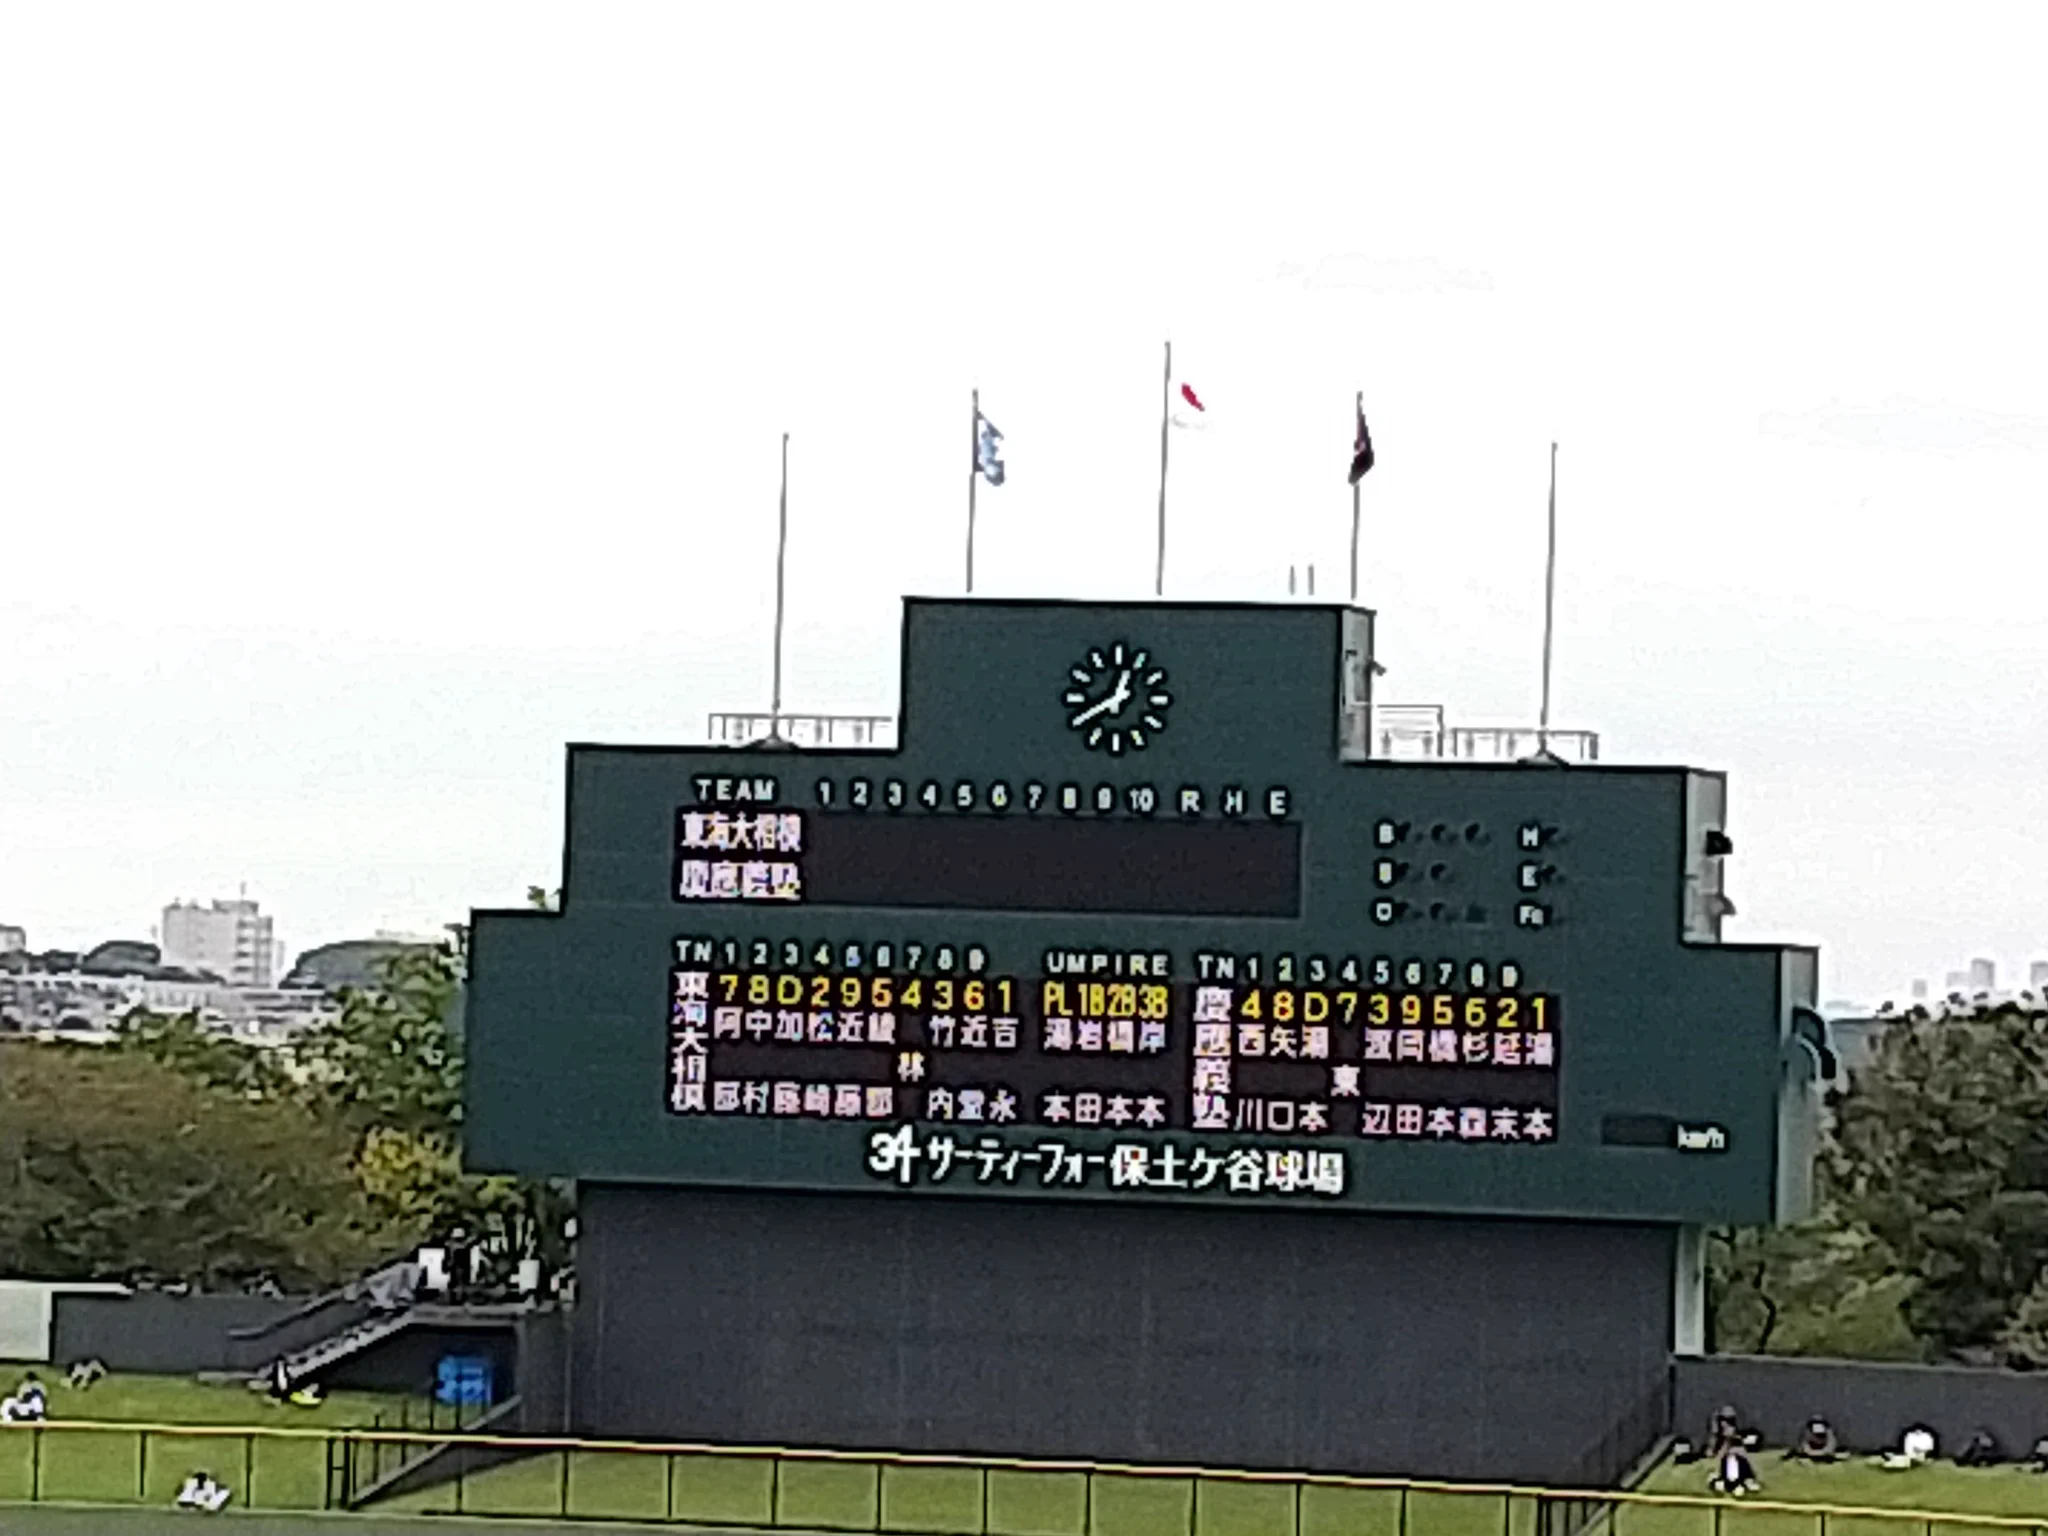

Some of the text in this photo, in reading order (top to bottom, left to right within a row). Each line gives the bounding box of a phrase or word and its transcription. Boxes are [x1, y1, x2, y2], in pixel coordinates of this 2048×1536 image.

[696, 779, 774, 801] TEAM
[820, 782, 830, 804] 1
[854, 782, 867, 805] 2
[888, 782, 902, 806] 3
[923, 784, 936, 806] 4
[958, 784, 972, 806] 5
[992, 785, 1007, 807] 6
[1029, 785, 1042, 809] 7
[1129, 788, 1154, 812] 10
[1181, 790, 1200, 812] R
[1270, 791, 1286, 815] E
[725, 943, 735, 963] 1
[754, 943, 767, 964] 2
[785, 943, 798, 965] 3
[814, 944, 830, 965] 4
[907, 946, 922, 970] 7
[1047, 952, 1168, 976] UMPIRE
[1248, 957, 1257, 979] 1
[1279, 957, 1293, 981] 2
[1310, 960, 1326, 982] 3
[1342, 960, 1357, 982] 4
[1374, 960, 1389, 984] 5
[1405, 963, 1421, 985] 6
[1439, 963, 1453, 984] 7
[719, 974, 738, 1002] 7
[748, 974, 770, 1005] 8
[811, 976, 830, 1007] 2
[840, 977, 861, 1008] 9
[900, 979, 922, 1009] 4
[932, 980, 953, 1010] 3
[963, 980, 985, 1011] 6
[997, 980, 1011, 1013] 1
[1043, 980, 1074, 1016] PL
[1240, 989, 1546, 1031] 4 8 D 7 3 9 5 6 2 1
[869, 1124, 922, 1184] 34
